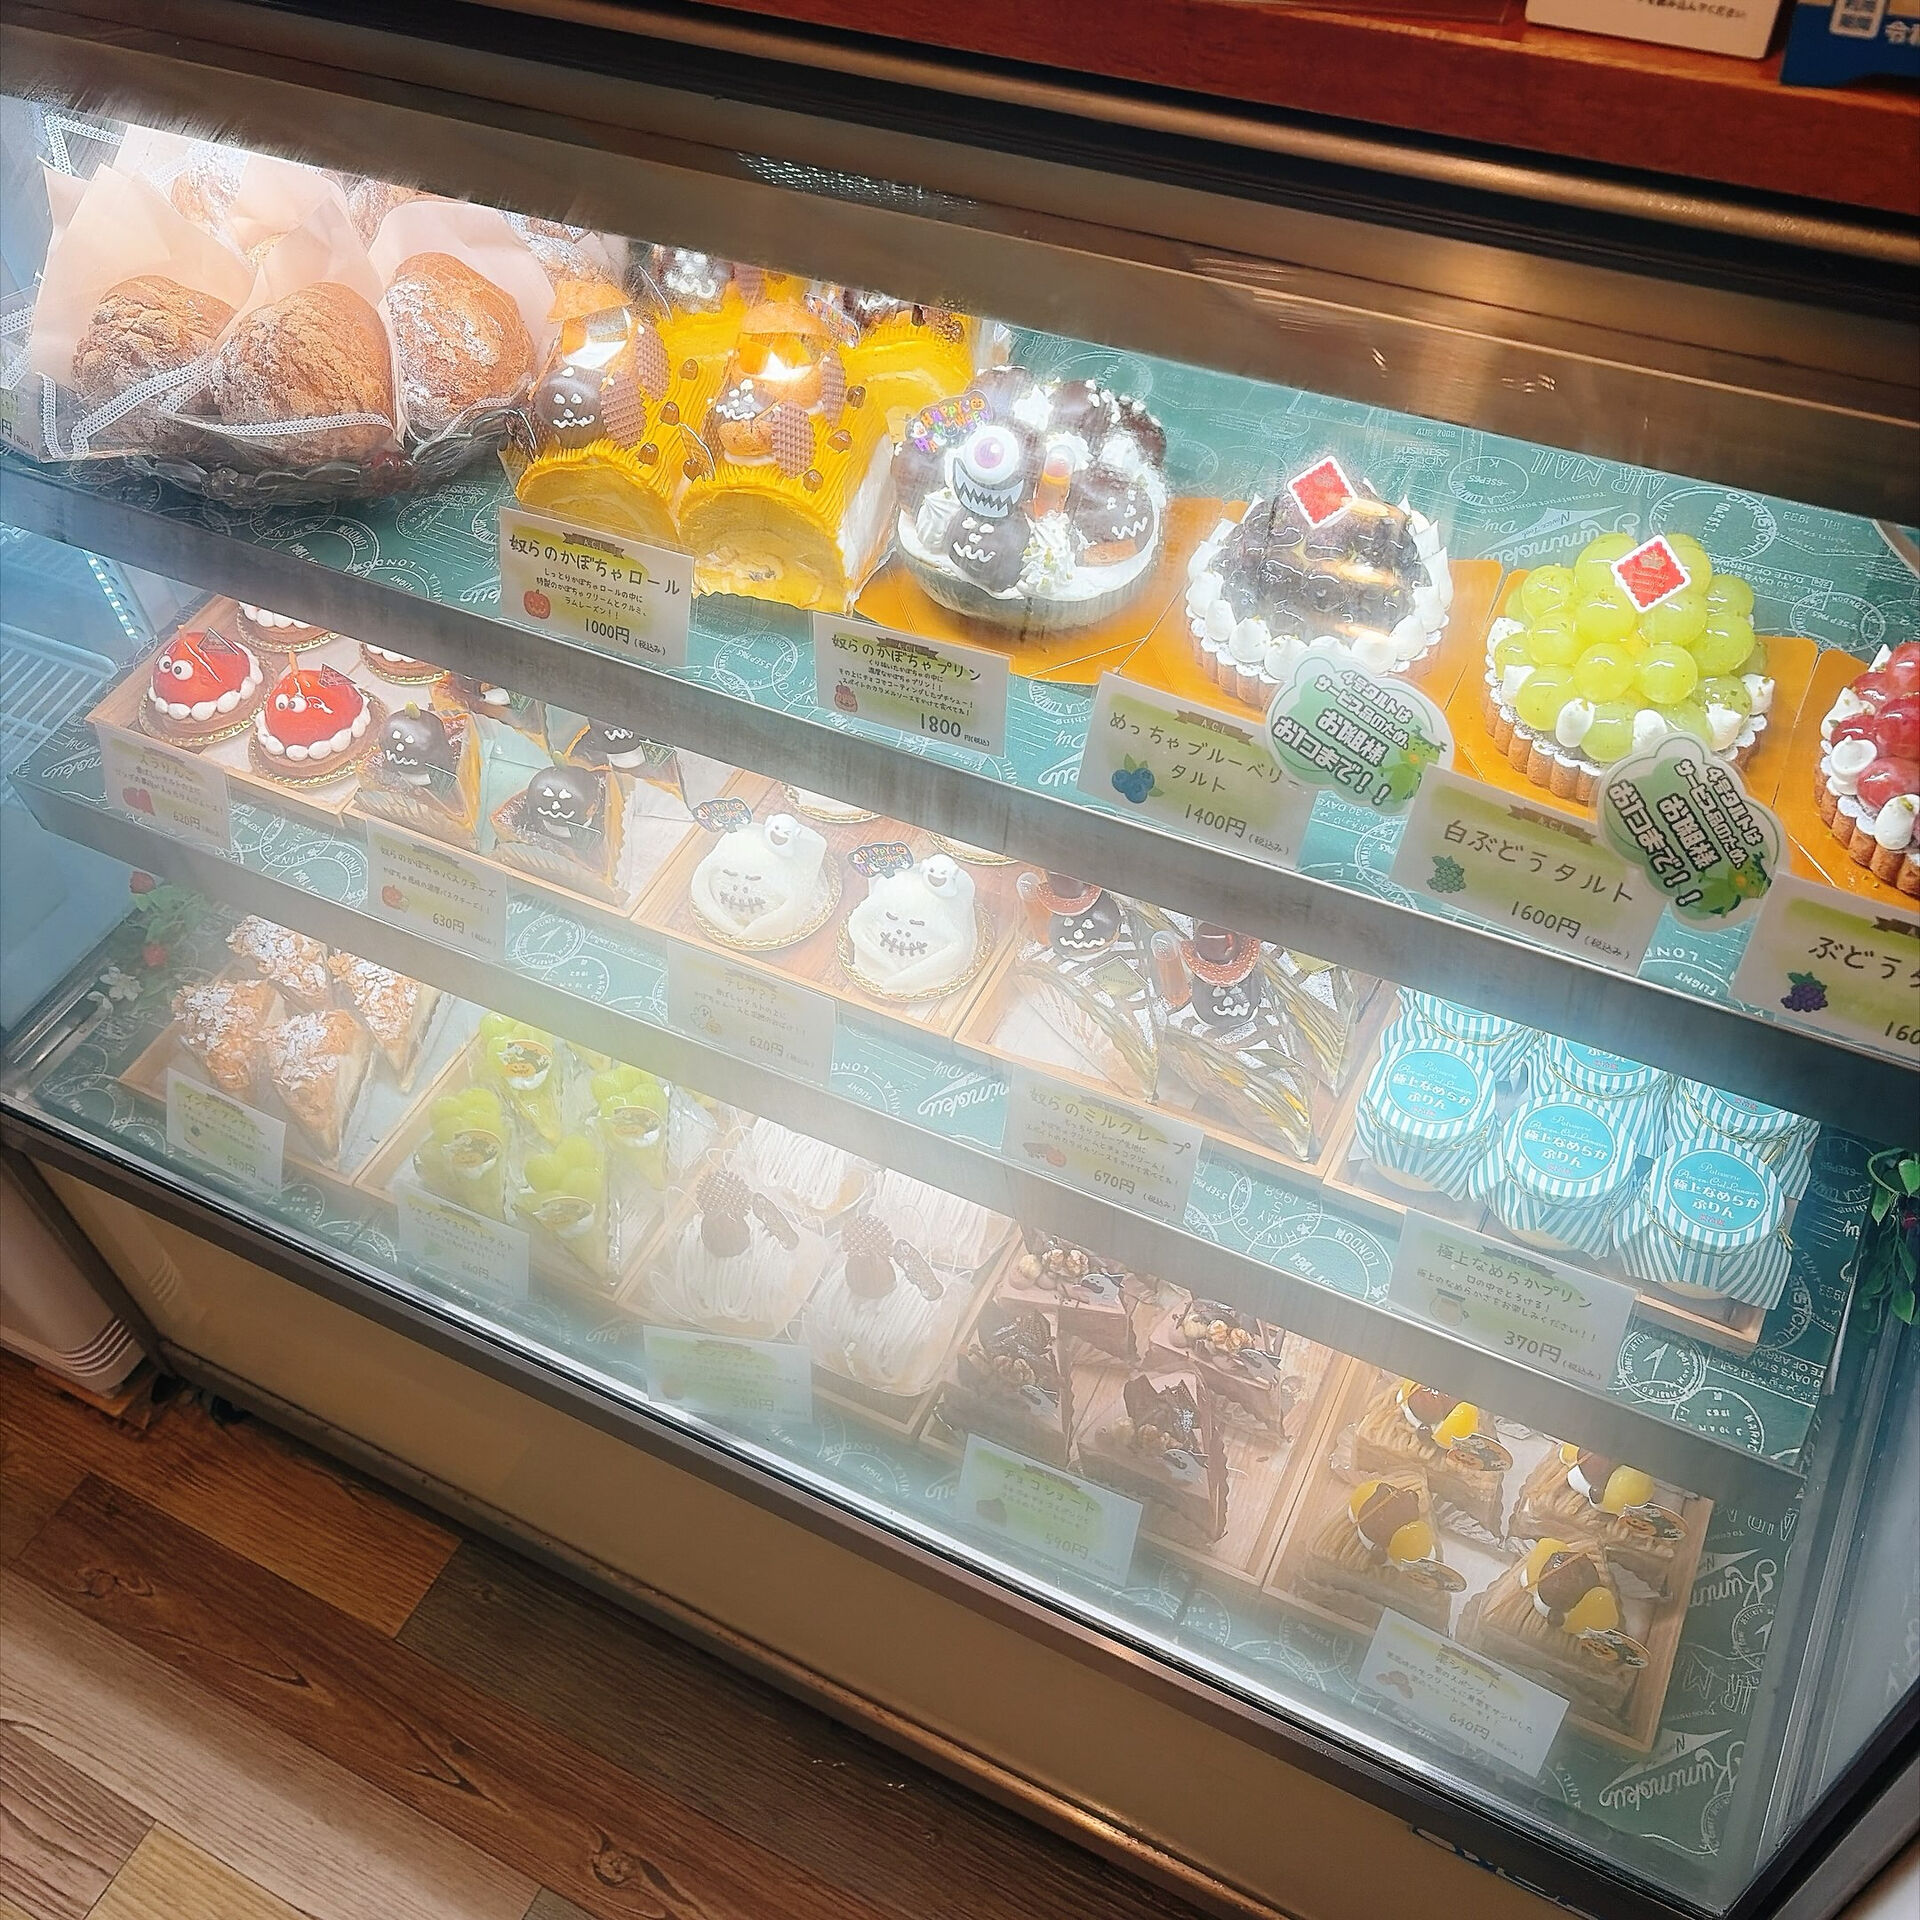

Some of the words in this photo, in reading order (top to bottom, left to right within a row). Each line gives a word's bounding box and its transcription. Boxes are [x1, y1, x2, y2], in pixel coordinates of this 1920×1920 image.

[1529, 448, 1607, 487] MAIL
[1610, 467, 1667, 499] AIR
[509, 534, 680, 596] 奴らのかぼちゃロール
[585, 618, 631, 645] 1000円
[831, 634, 982, 681] 奴らのかぼちゃプリン
[1341, 670, 1413, 724] 4号タルトは
[919, 712, 962, 738] 1800
[1110, 711, 1301, 788] めっちゃブルーベリー
[1171, 763, 1227, 793] タルト
[1185, 803, 1248, 839] 1400円
[1706, 767, 1764, 847] 4号タルトは
[1444, 819, 1633, 903] 白ぶどうタルト
[432, 912, 465, 935] 630円
[1511, 901, 1582, 939] 1600円
[1393, 1072, 1471, 1107] 極上なめらか
[1030, 1087, 1192, 1155] 奴らのミルクレープ
[1524, 1128, 1607, 1161] 極上なめらか
[1094, 1168, 1136, 1195] 670円
[1673, 1177, 1761, 1210] 極上なめらか
[1436, 1241, 1593, 1309] 極上なめらかプリン
[1503, 1329, 1563, 1364] 370円
